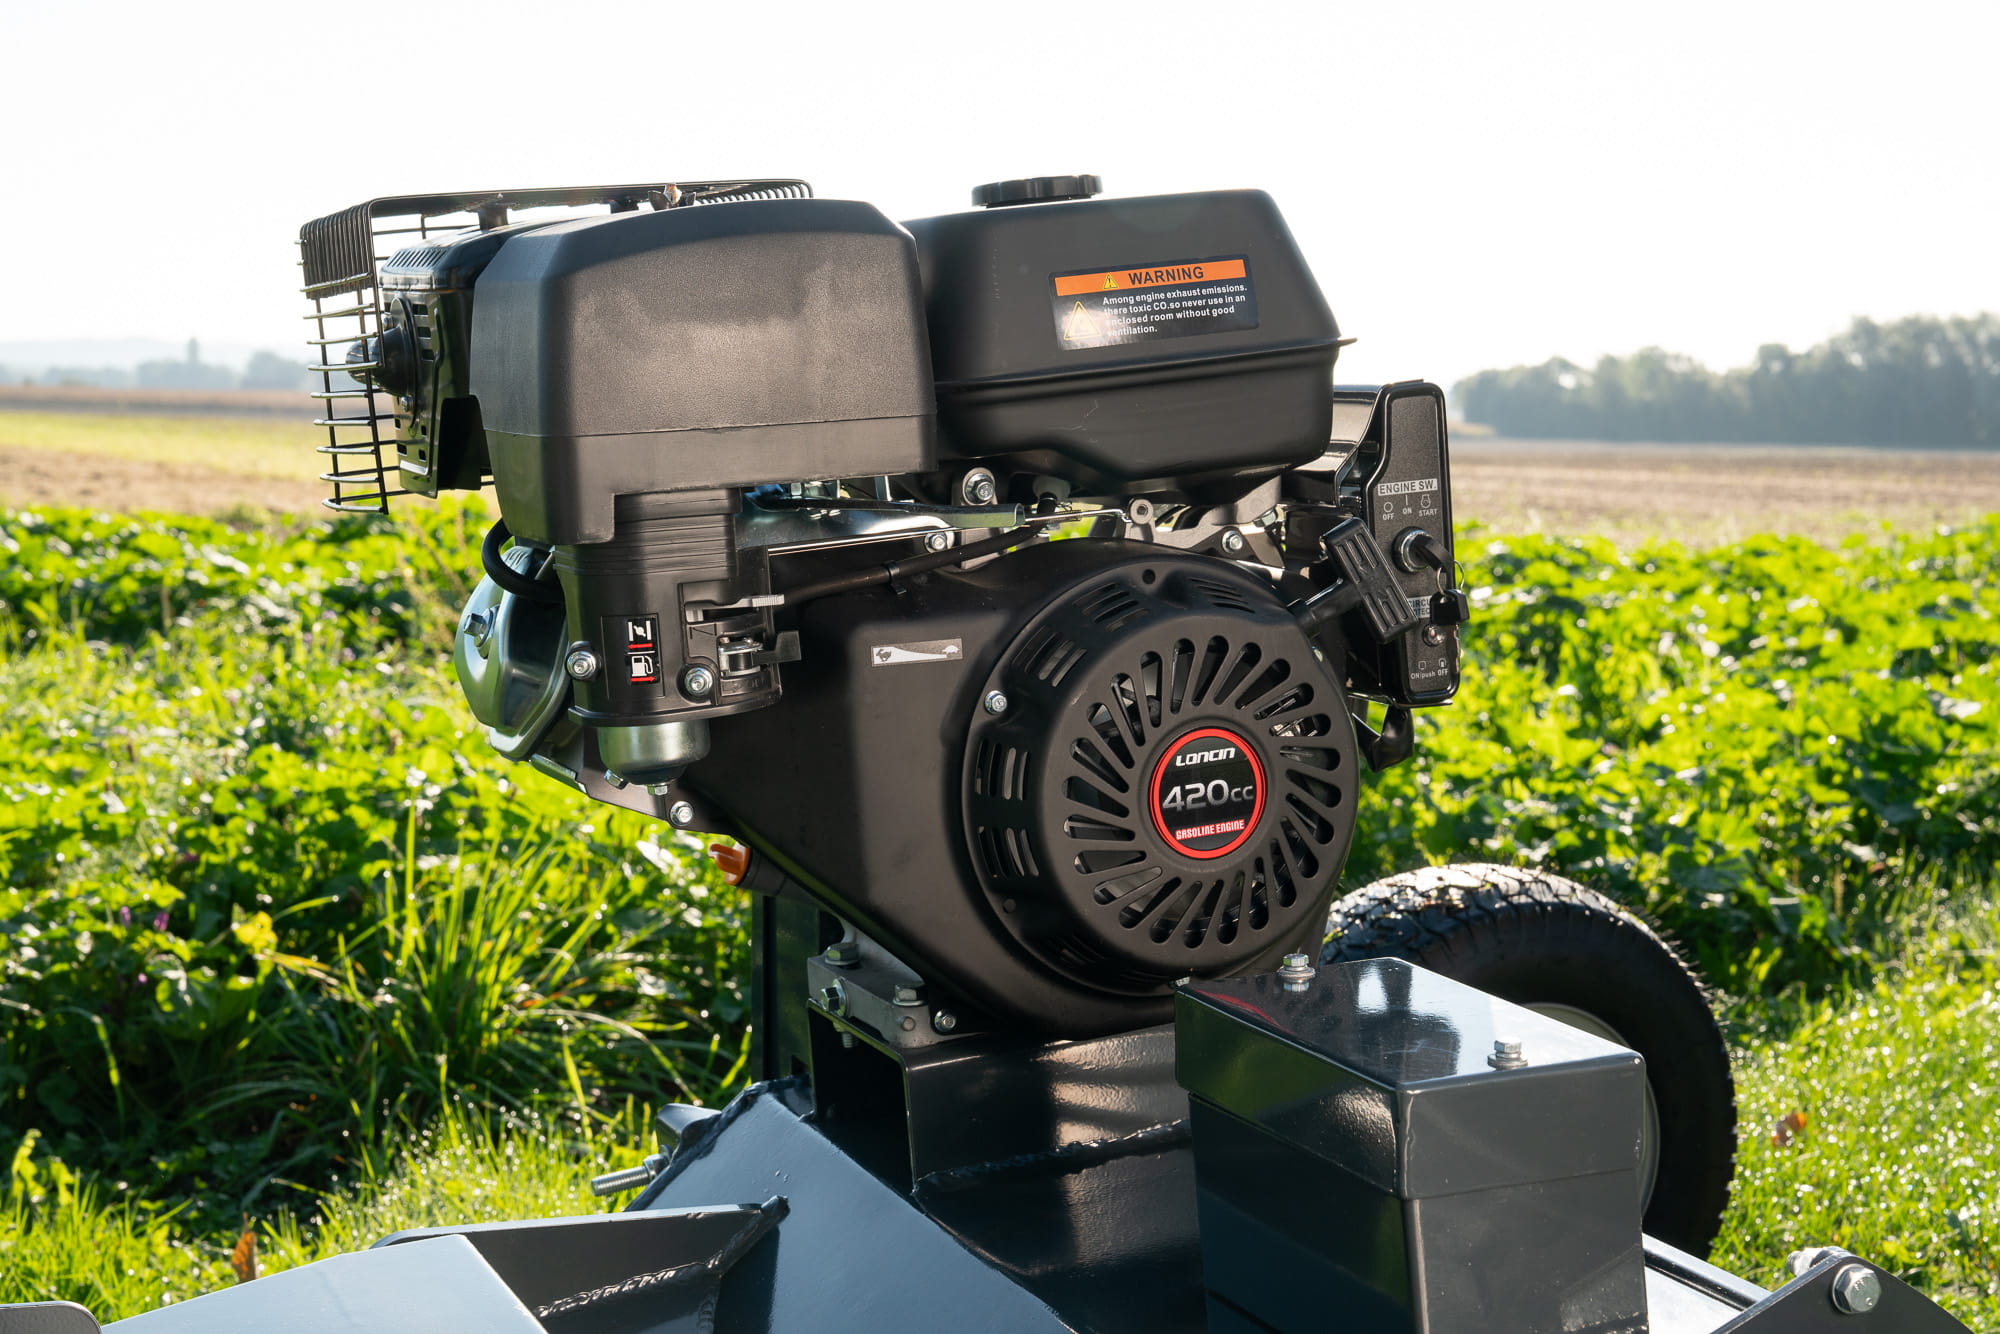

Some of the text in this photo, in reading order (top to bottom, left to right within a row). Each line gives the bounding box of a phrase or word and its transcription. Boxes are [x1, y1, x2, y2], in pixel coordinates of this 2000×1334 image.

[1128, 266, 1204, 286] WARNING
[1102, 284, 1247, 305] Among engine exhaust emissions.
[1104, 307, 1128, 315] there
[1129, 303, 1152, 313] toxic
[1182, 300, 1206, 308] never
[1207, 297, 1224, 305] use
[1225, 295, 1234, 303] in
[1106, 304, 1235, 325] nclosed room without good
[1379, 479, 1437, 495] ENGINE SW.
[1402, 507, 1412, 515] ON
[1418, 508, 1437, 517] START
[1437, 668, 1449, 676] OFF
[1162, 779, 1254, 812] 420cc
[1175, 819, 1245, 840] GASOLINE ENGINE
